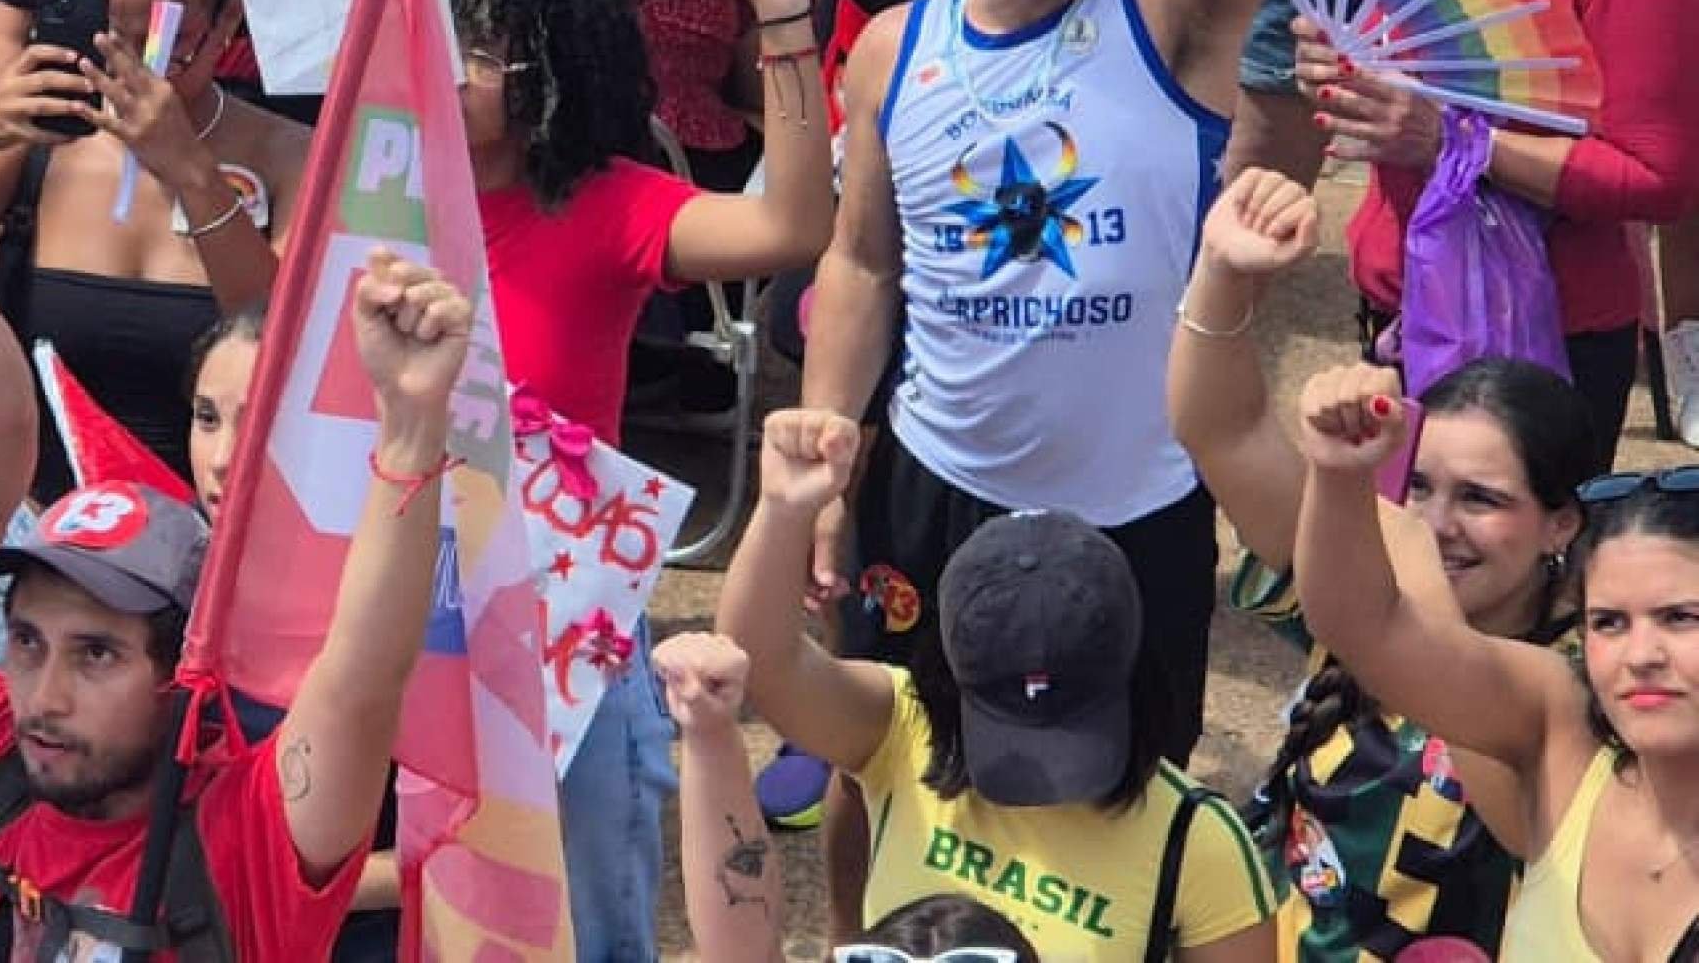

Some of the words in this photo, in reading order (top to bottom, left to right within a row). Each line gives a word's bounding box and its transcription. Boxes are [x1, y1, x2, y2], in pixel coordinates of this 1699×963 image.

[1087, 207, 1127, 246] 13
[55, 491, 134, 533] 13
[924, 826, 1116, 940] BRASIL
